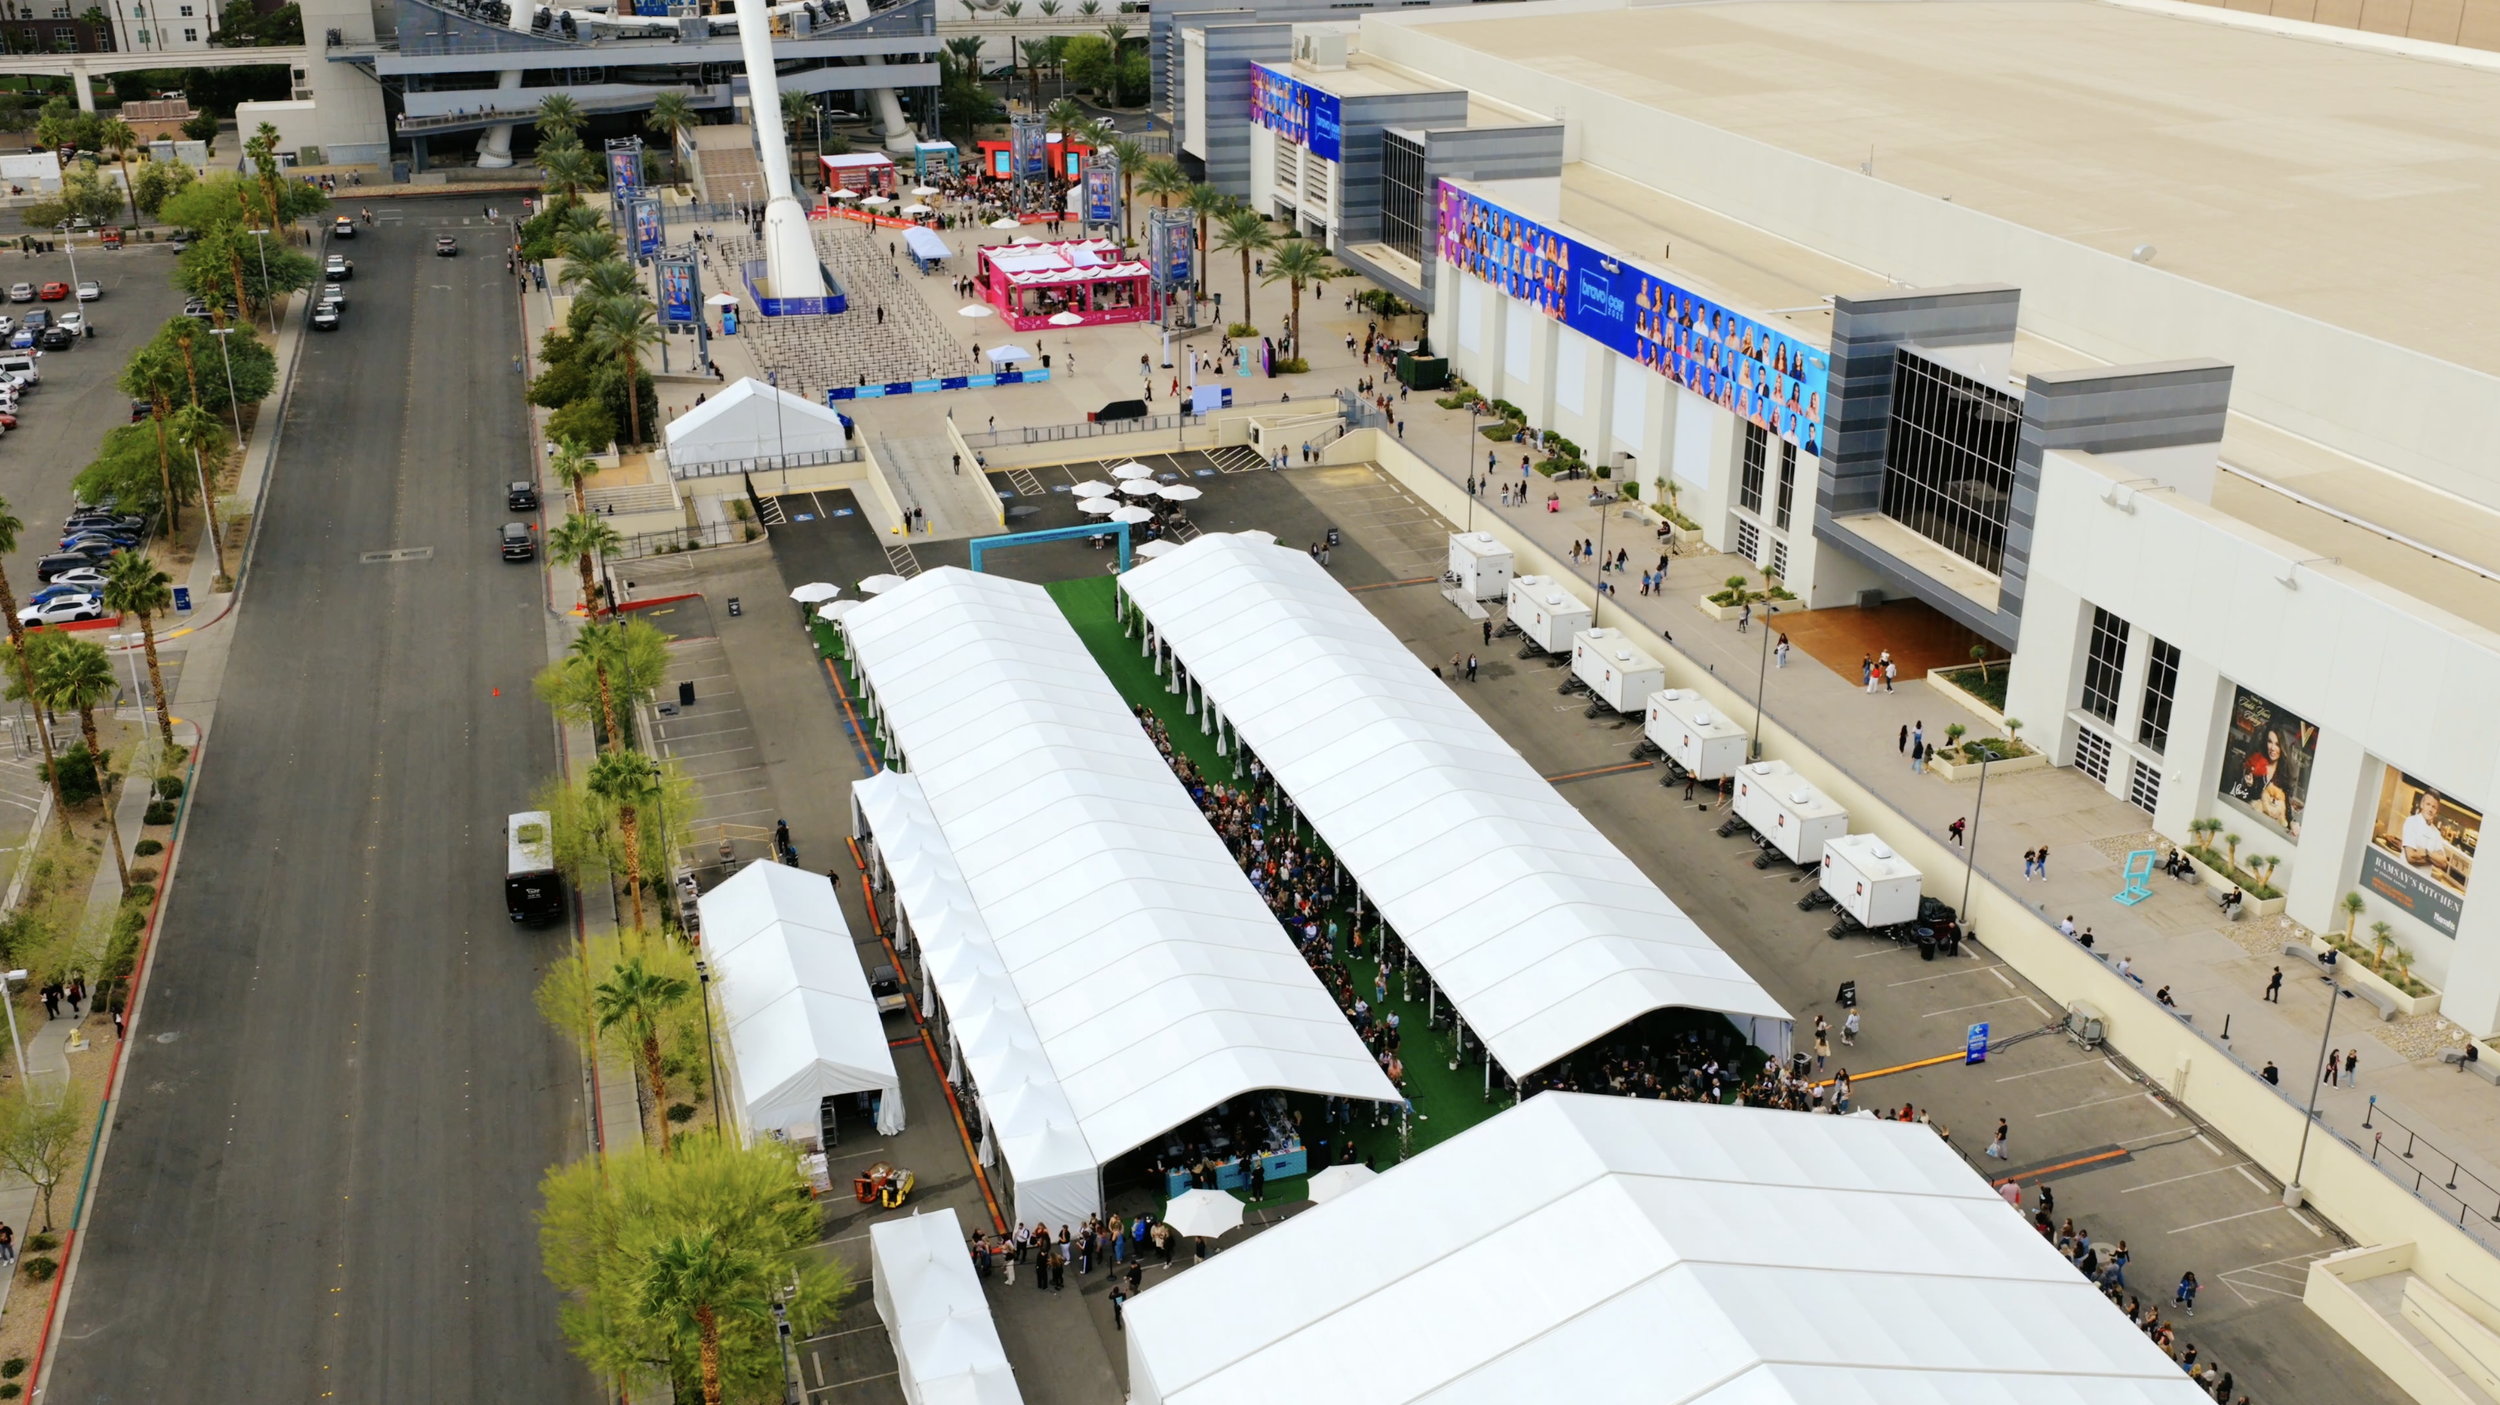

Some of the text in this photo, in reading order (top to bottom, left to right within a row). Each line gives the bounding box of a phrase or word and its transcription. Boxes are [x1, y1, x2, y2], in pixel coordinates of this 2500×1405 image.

[1582, 277, 1606, 304] bravo
[2375, 857, 2417, 888] RAMSAY'S
[2418, 882, 2461, 913] KITCHEN
